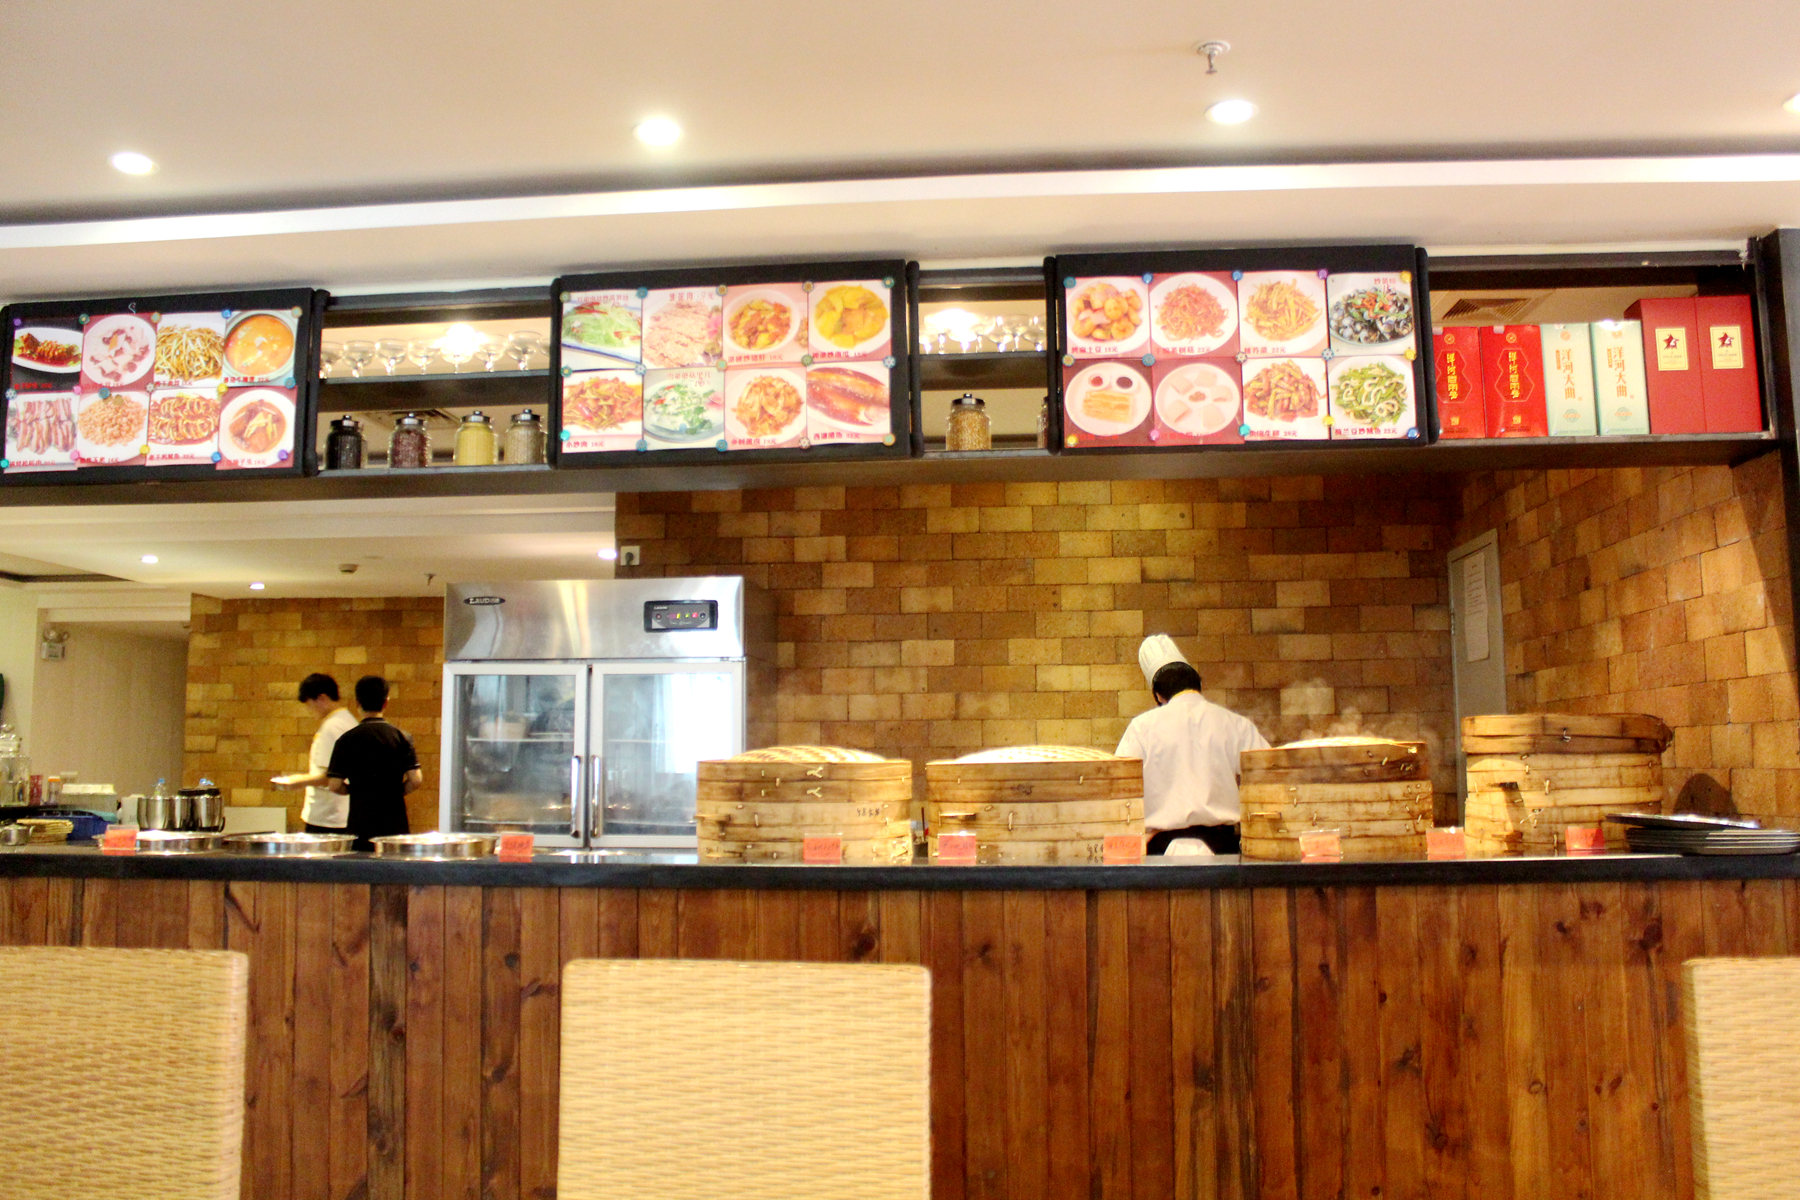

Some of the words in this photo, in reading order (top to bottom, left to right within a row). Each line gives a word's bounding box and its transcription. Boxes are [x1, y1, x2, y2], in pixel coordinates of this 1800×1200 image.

[1561, 348, 1576, 400] 洋河大曲
[1613, 346, 1628, 398] 洋河大曲
[1383, 427, 1398, 435] 22元
